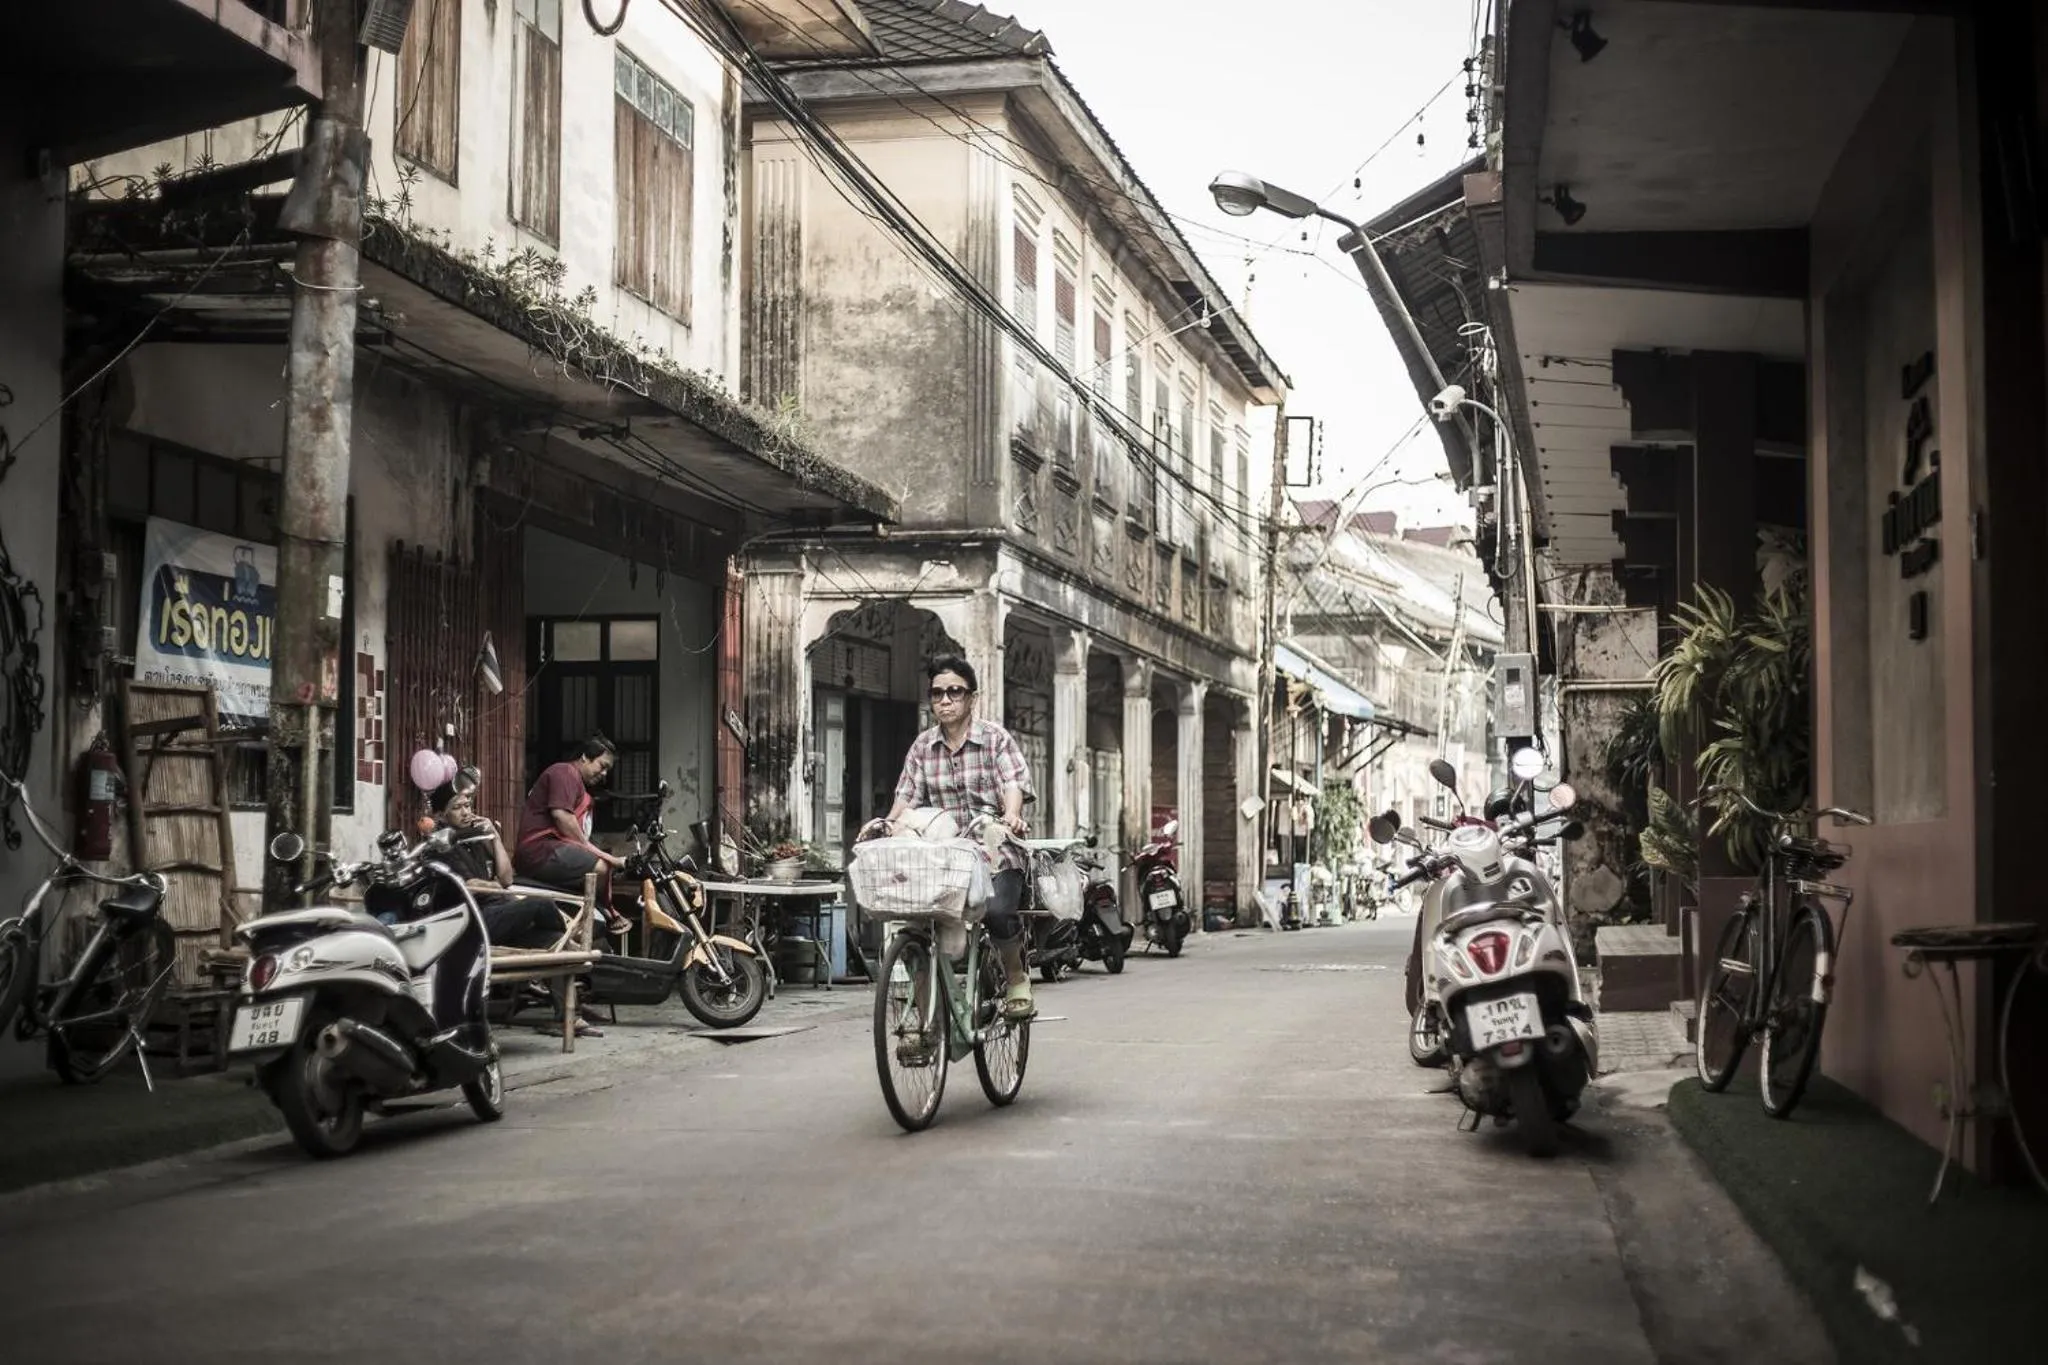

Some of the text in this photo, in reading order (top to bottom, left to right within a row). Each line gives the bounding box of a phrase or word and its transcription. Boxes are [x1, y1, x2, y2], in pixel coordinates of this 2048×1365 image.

[159, 575, 275, 660] เรือท่องเ
[248, 1030, 279, 1048] 148
